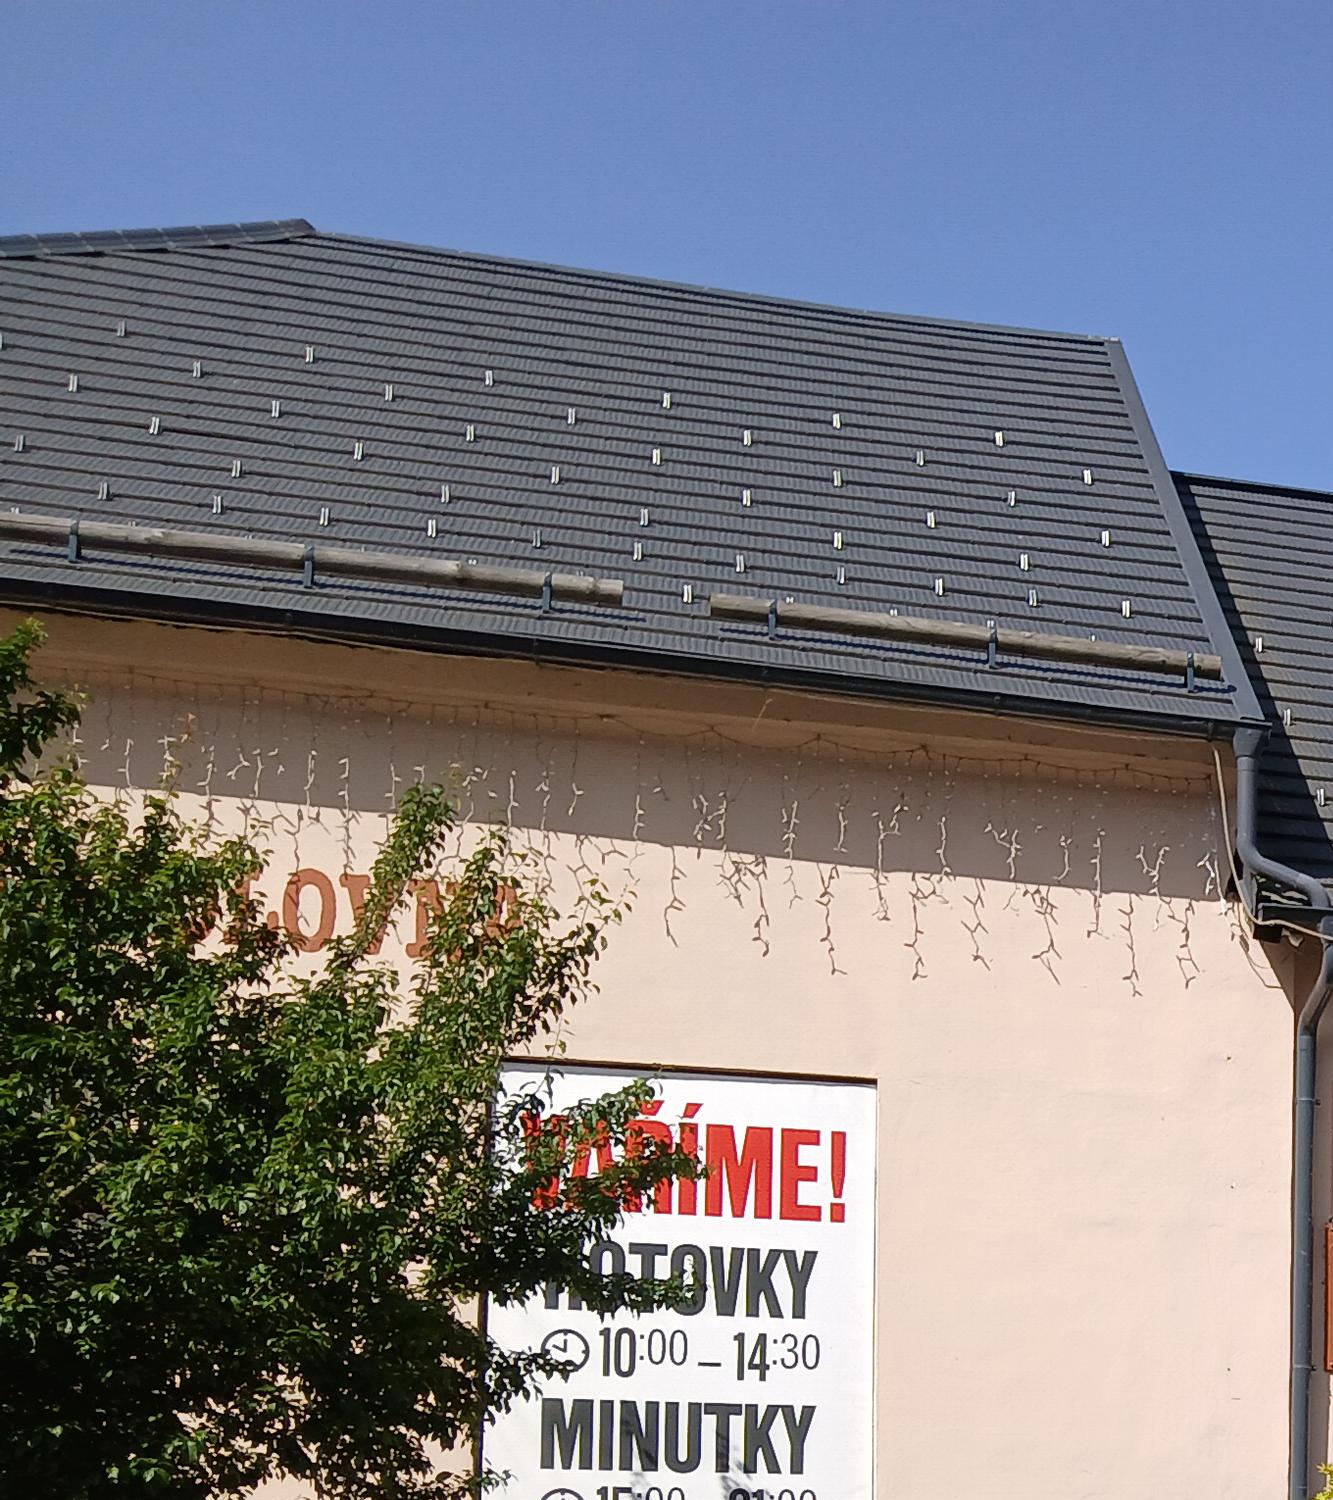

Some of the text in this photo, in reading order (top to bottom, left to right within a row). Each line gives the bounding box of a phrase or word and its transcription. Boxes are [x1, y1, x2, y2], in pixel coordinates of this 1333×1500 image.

[598, 1327, 689, 1378] 10:00
[733, 1332, 821, 1382] 14:30
[540, 1398, 817, 1475] MINUTKY
